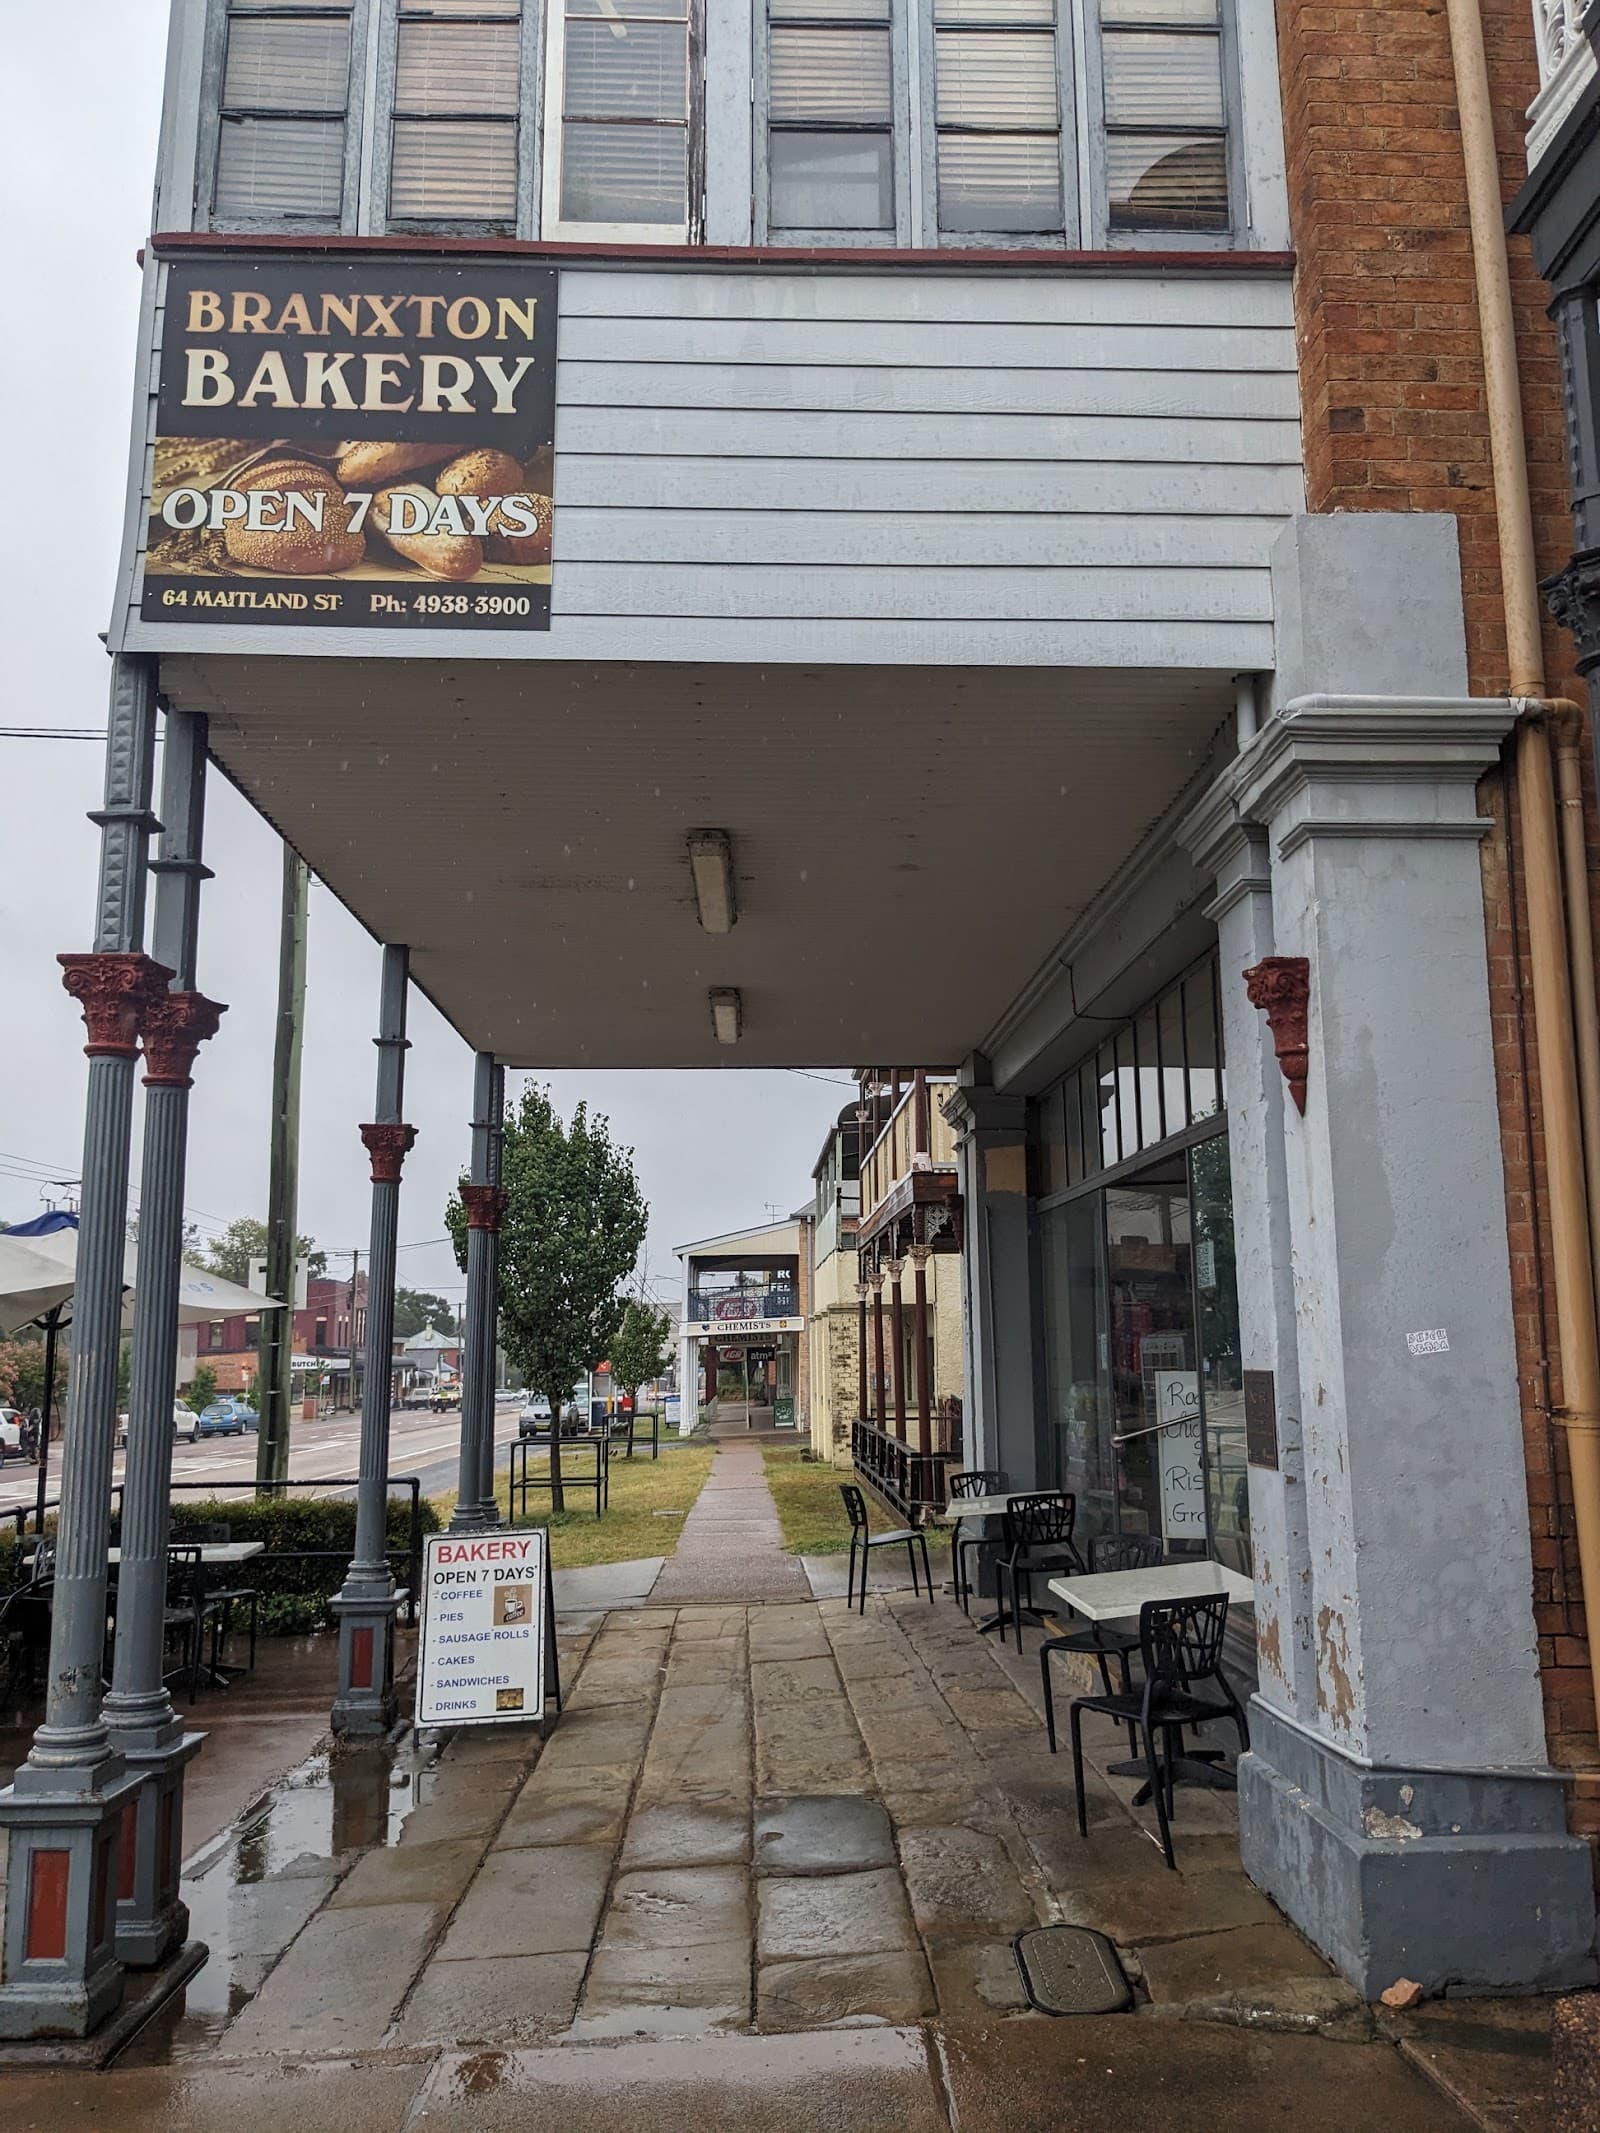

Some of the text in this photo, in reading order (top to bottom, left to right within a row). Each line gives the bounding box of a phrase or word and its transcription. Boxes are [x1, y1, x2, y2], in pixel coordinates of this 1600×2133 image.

[184, 290, 538, 341] BRANXTON
[181, 348, 535, 414] BAKERY
[161, 487, 539, 538] OPEN 7 DAYS
[162, 589, 188, 606] 64
[192, 590, 309, 610] MAITLAND
[369, 594, 407, 613] Ph:
[717, 1321, 772, 1332] CHEMISTS
[437, 1540, 532, 1564] BAKERY
[433, 1566, 535, 1585] OPEN 7 DAYS
[440, 1589, 483, 1600] COFFEE
[439, 1612, 464, 1622] PIES
[438, 1630, 529, 1644] SAUSAGE ROLLS
[437, 1655, 475, 1666] CAKES
[436, 1675, 510, 1689] SANDWICHES
[435, 1700, 477, 1711] DRINKS
